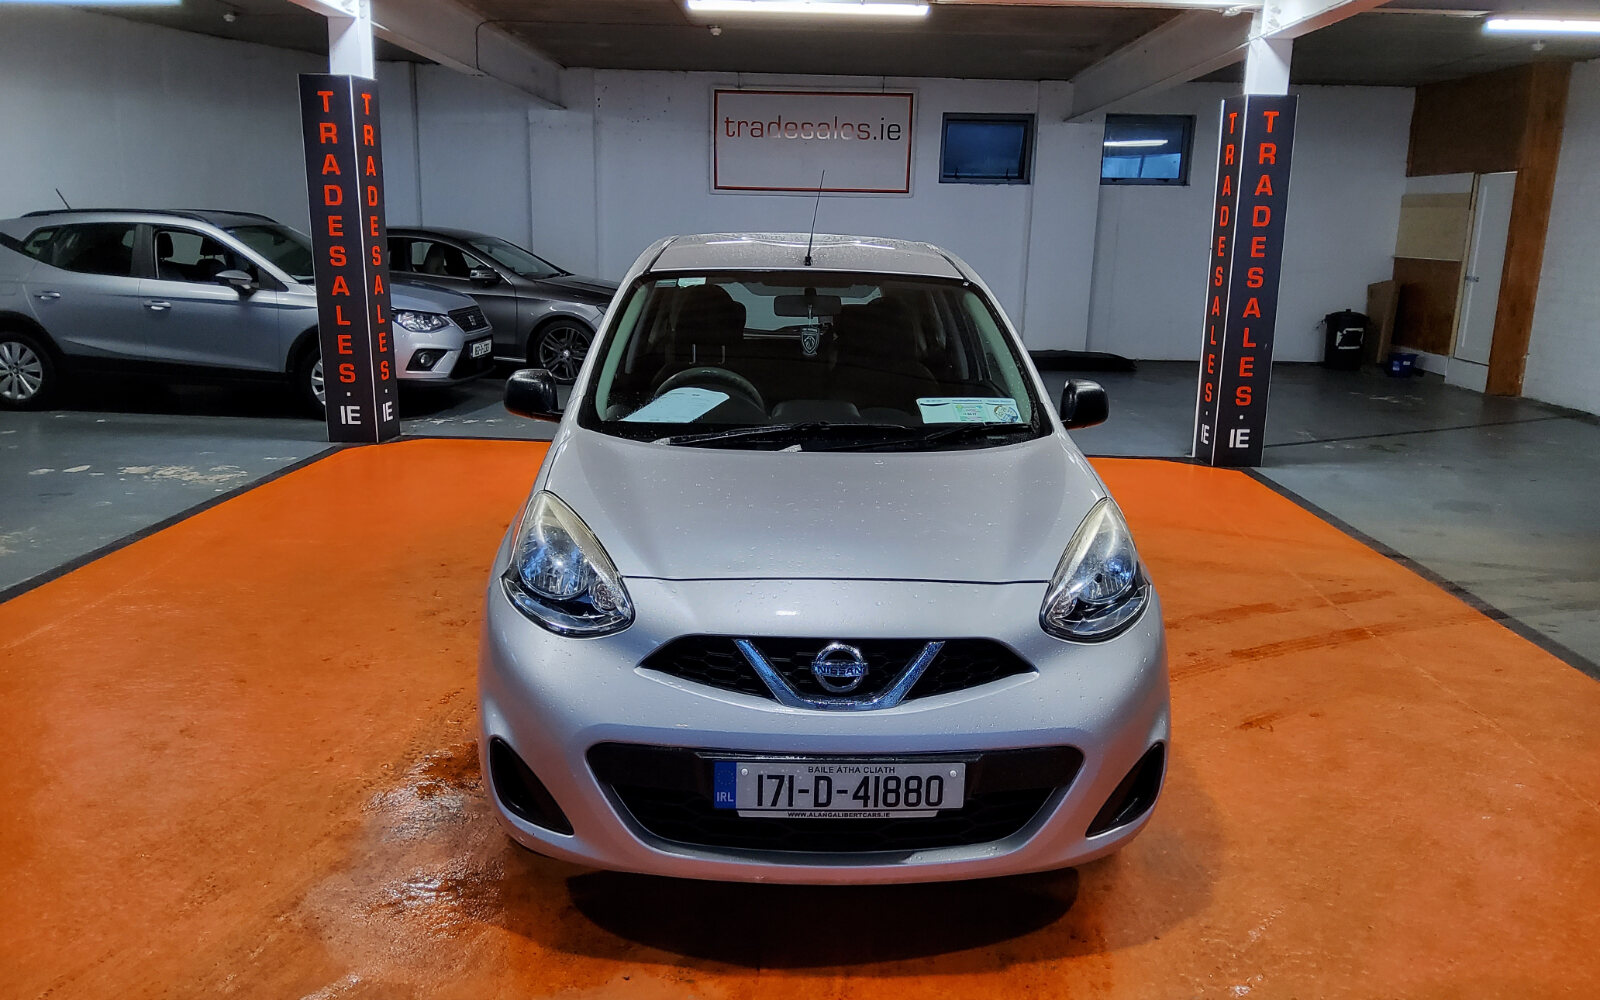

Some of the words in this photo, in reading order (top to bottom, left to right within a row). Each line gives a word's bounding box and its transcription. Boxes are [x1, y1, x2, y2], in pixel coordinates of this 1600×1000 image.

[724, 115, 901, 141] tradesales.ie
[816, 665, 864, 675] NISSAN
[807, 766, 834, 774] BAILE
[863, 766, 896, 774] CLIATH
[756, 774, 944, 808] 171-D-41880
[716, 792, 734, 802] IRL
